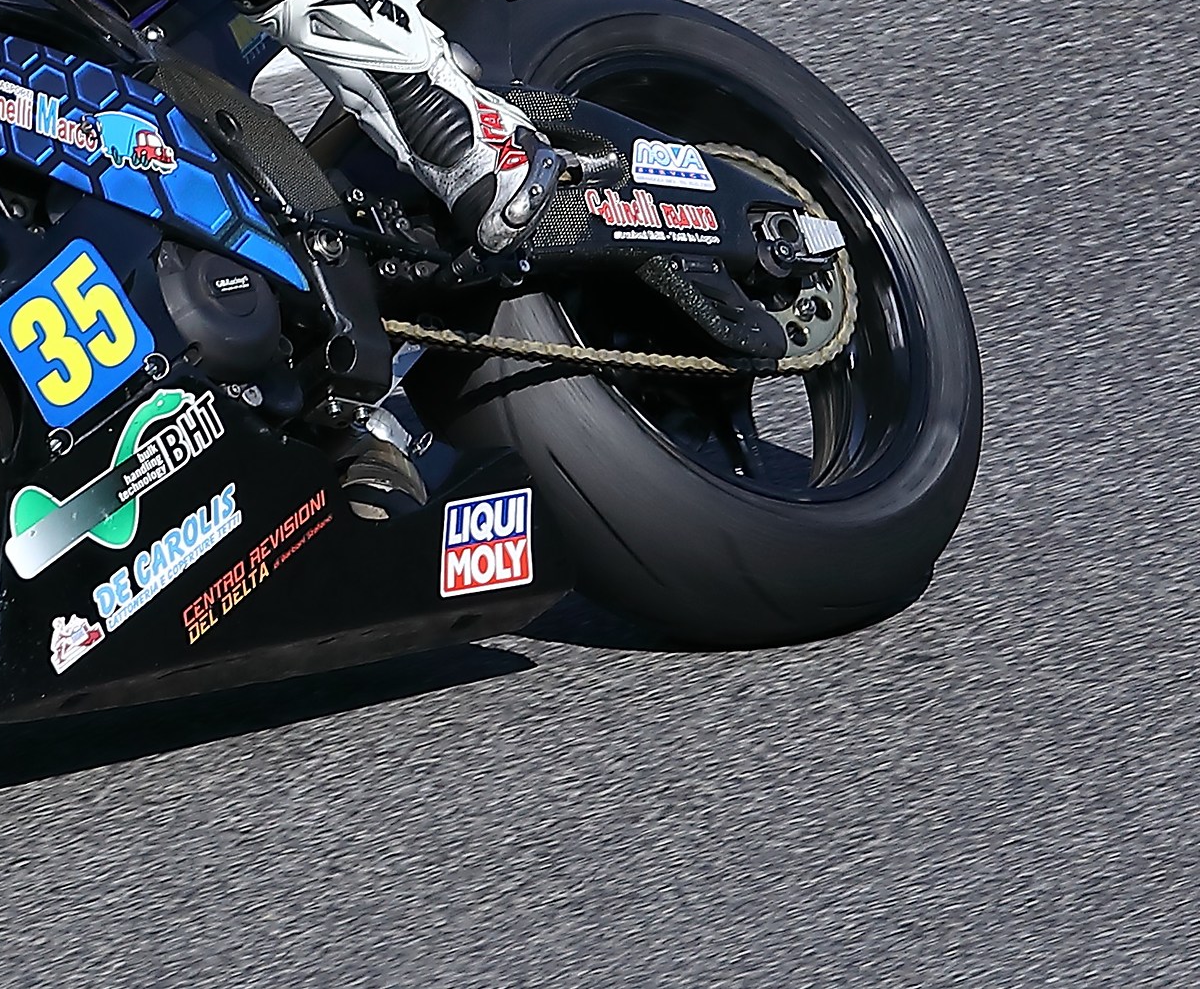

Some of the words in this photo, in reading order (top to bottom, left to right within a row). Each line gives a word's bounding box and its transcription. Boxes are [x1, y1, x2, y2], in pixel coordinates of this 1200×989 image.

[9, 251, 137, 407] 35
[136, 443, 158, 464] bulk
[158, 390, 225, 471] BHT
[118, 464, 167, 502] technology
[123, 453, 164, 486] handling
[94, 567, 133, 618] DE
[134, 483, 236, 589] CAROLIS
[165, 534, 219, 580] COPERTURE
[216, 512, 242, 538] TETTI
[447, 495, 526, 547] LIQUI
[183, 560, 245, 628] CENTRO
[250, 489, 326, 570] REVISIONI
[446, 538, 528, 589] MOLY
[188, 609, 219, 645] DEL
[221, 561, 270, 616] DELTA
